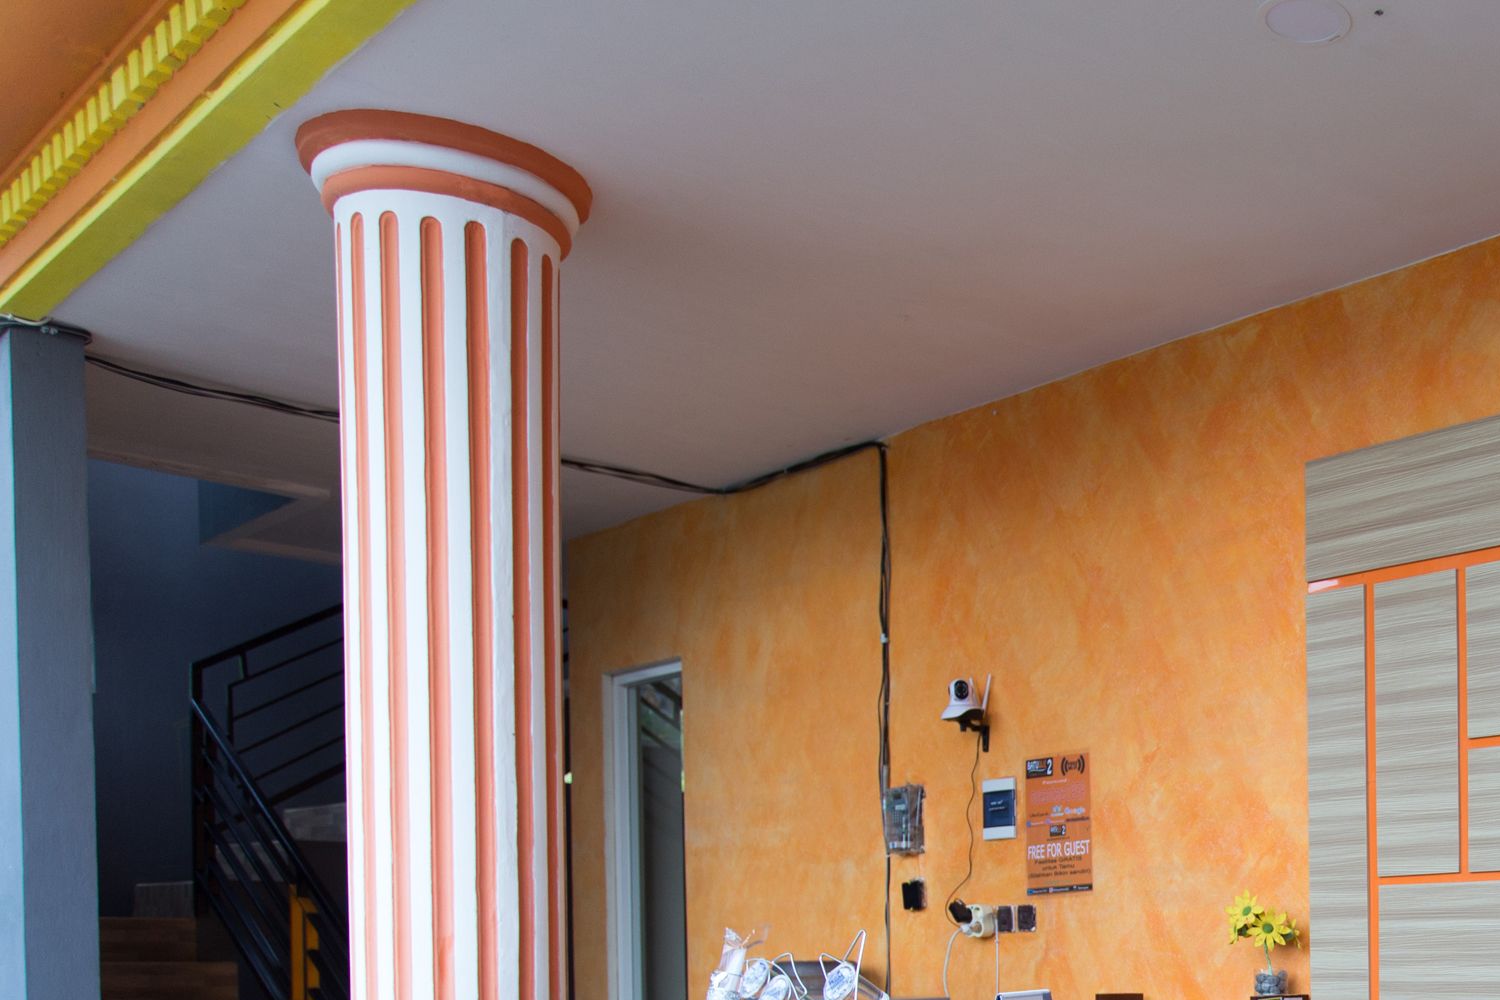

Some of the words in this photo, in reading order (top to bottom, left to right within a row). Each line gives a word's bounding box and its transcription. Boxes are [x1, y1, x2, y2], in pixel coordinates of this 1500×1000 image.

[1027, 845, 1045, 860] FREE
[1047, 843, 1062, 857] FOR
[1064, 840, 1090, 856] GUEST
